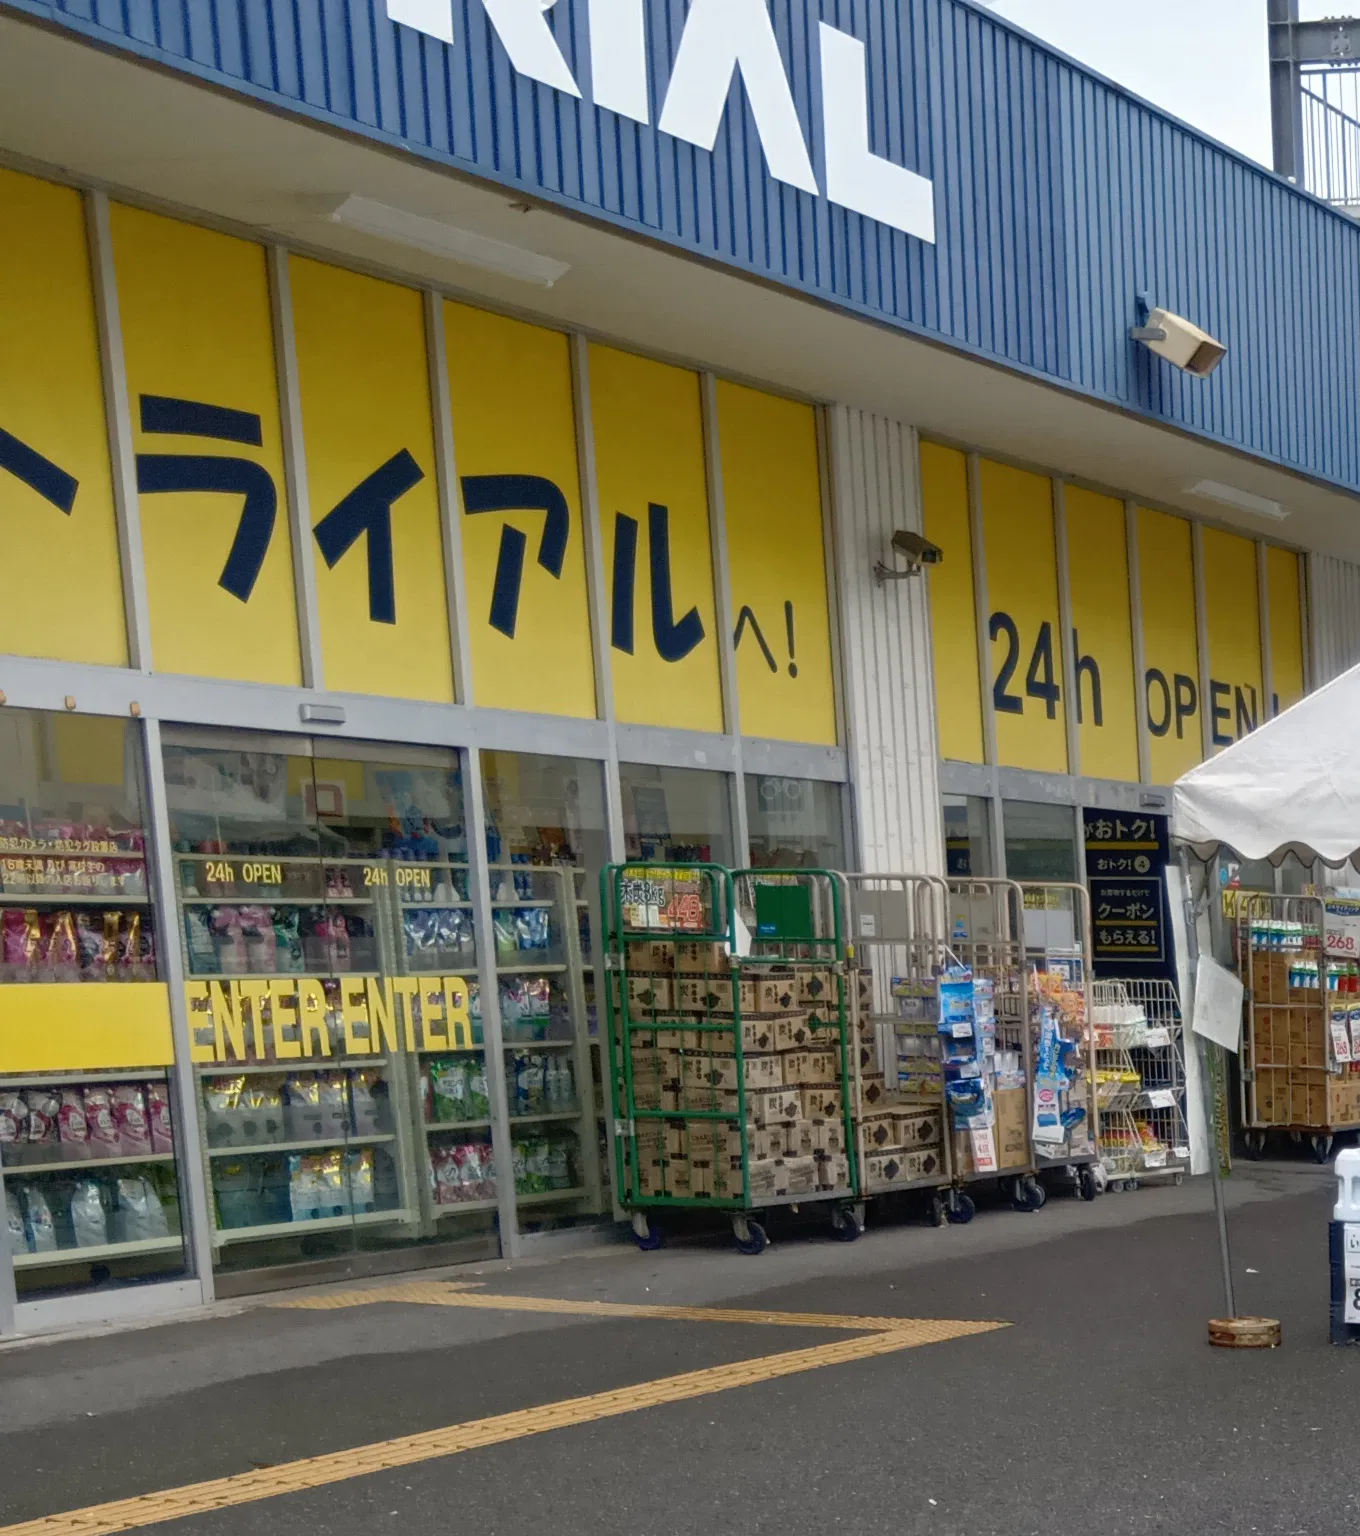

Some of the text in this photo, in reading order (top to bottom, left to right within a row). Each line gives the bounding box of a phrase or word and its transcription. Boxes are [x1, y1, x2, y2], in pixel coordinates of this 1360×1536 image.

[988, 611, 1103, 727] 24h
[206, 862, 282, 884] 24h OPEN
[364, 867, 431, 887] 24h OPEN
[1098, 903, 1154, 919] クーポン
[1100, 930, 1155, 945] もらえる!
[1328, 936, 1354, 949] 268
[184, 979, 331, 1062] ENTER
[341, 977, 474, 1054] ENTER
